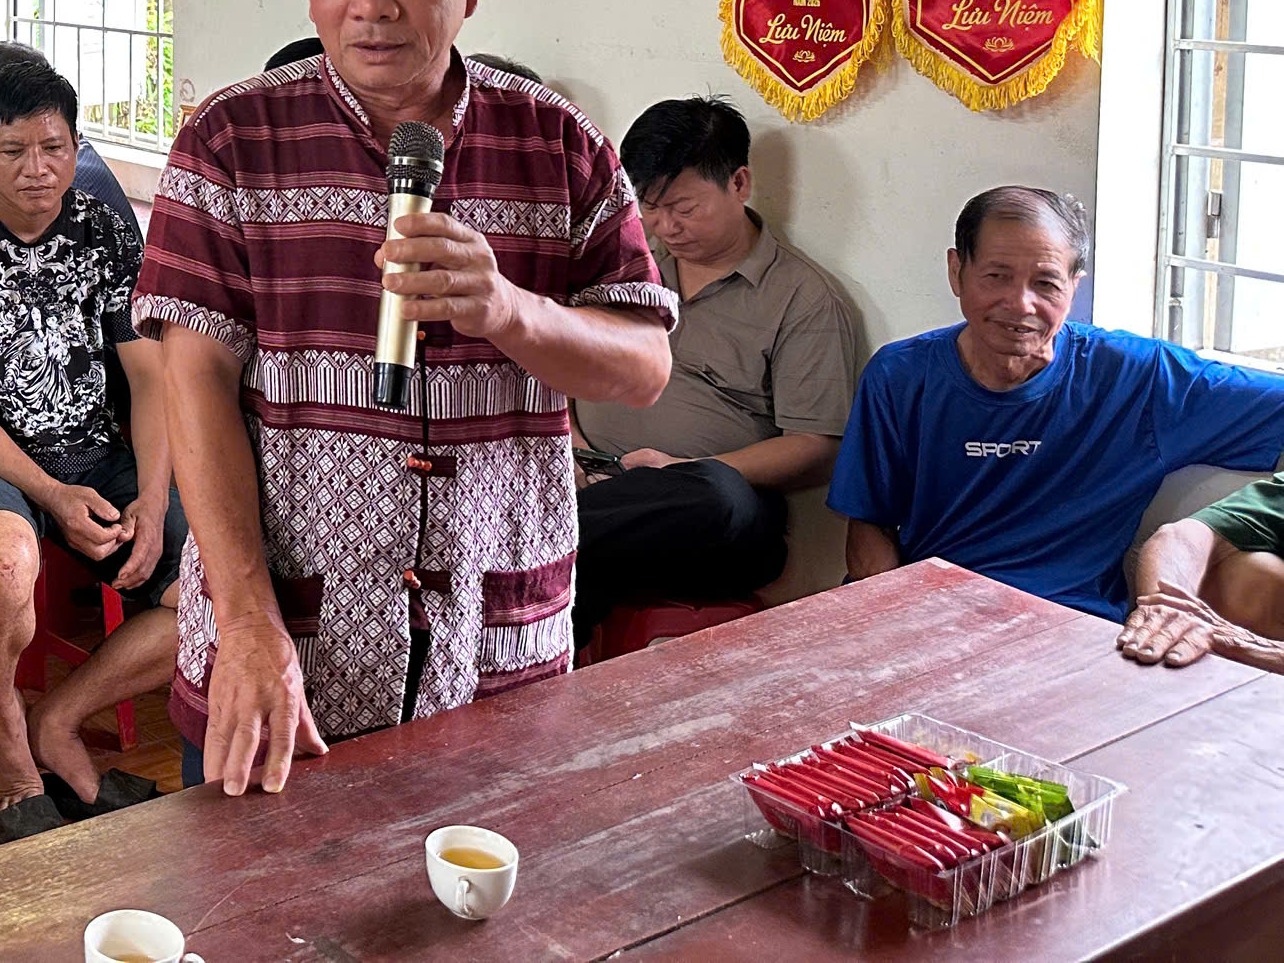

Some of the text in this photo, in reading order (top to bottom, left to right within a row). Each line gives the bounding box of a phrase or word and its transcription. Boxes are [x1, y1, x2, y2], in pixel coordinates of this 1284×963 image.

[759, 13, 846, 47] Lưu Niệm
[965, 440, 1042, 458] SPORT
